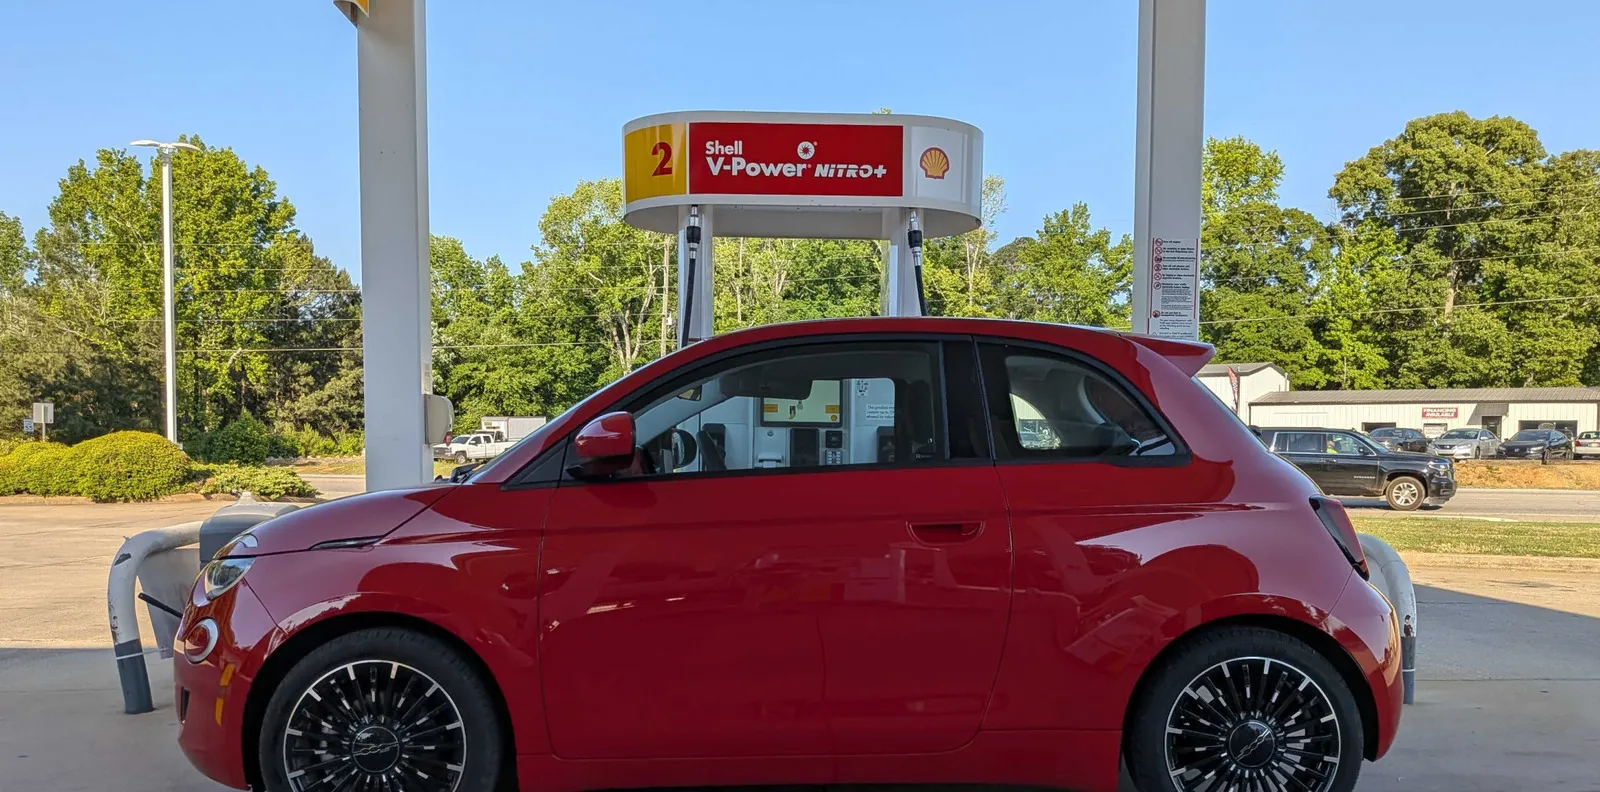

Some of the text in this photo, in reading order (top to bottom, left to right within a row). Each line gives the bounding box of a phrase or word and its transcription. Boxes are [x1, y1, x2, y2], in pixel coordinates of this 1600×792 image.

[705, 140, 743, 155] Shell
[651, 141, 673, 177] 2
[705, 156, 806, 178] V-Power
